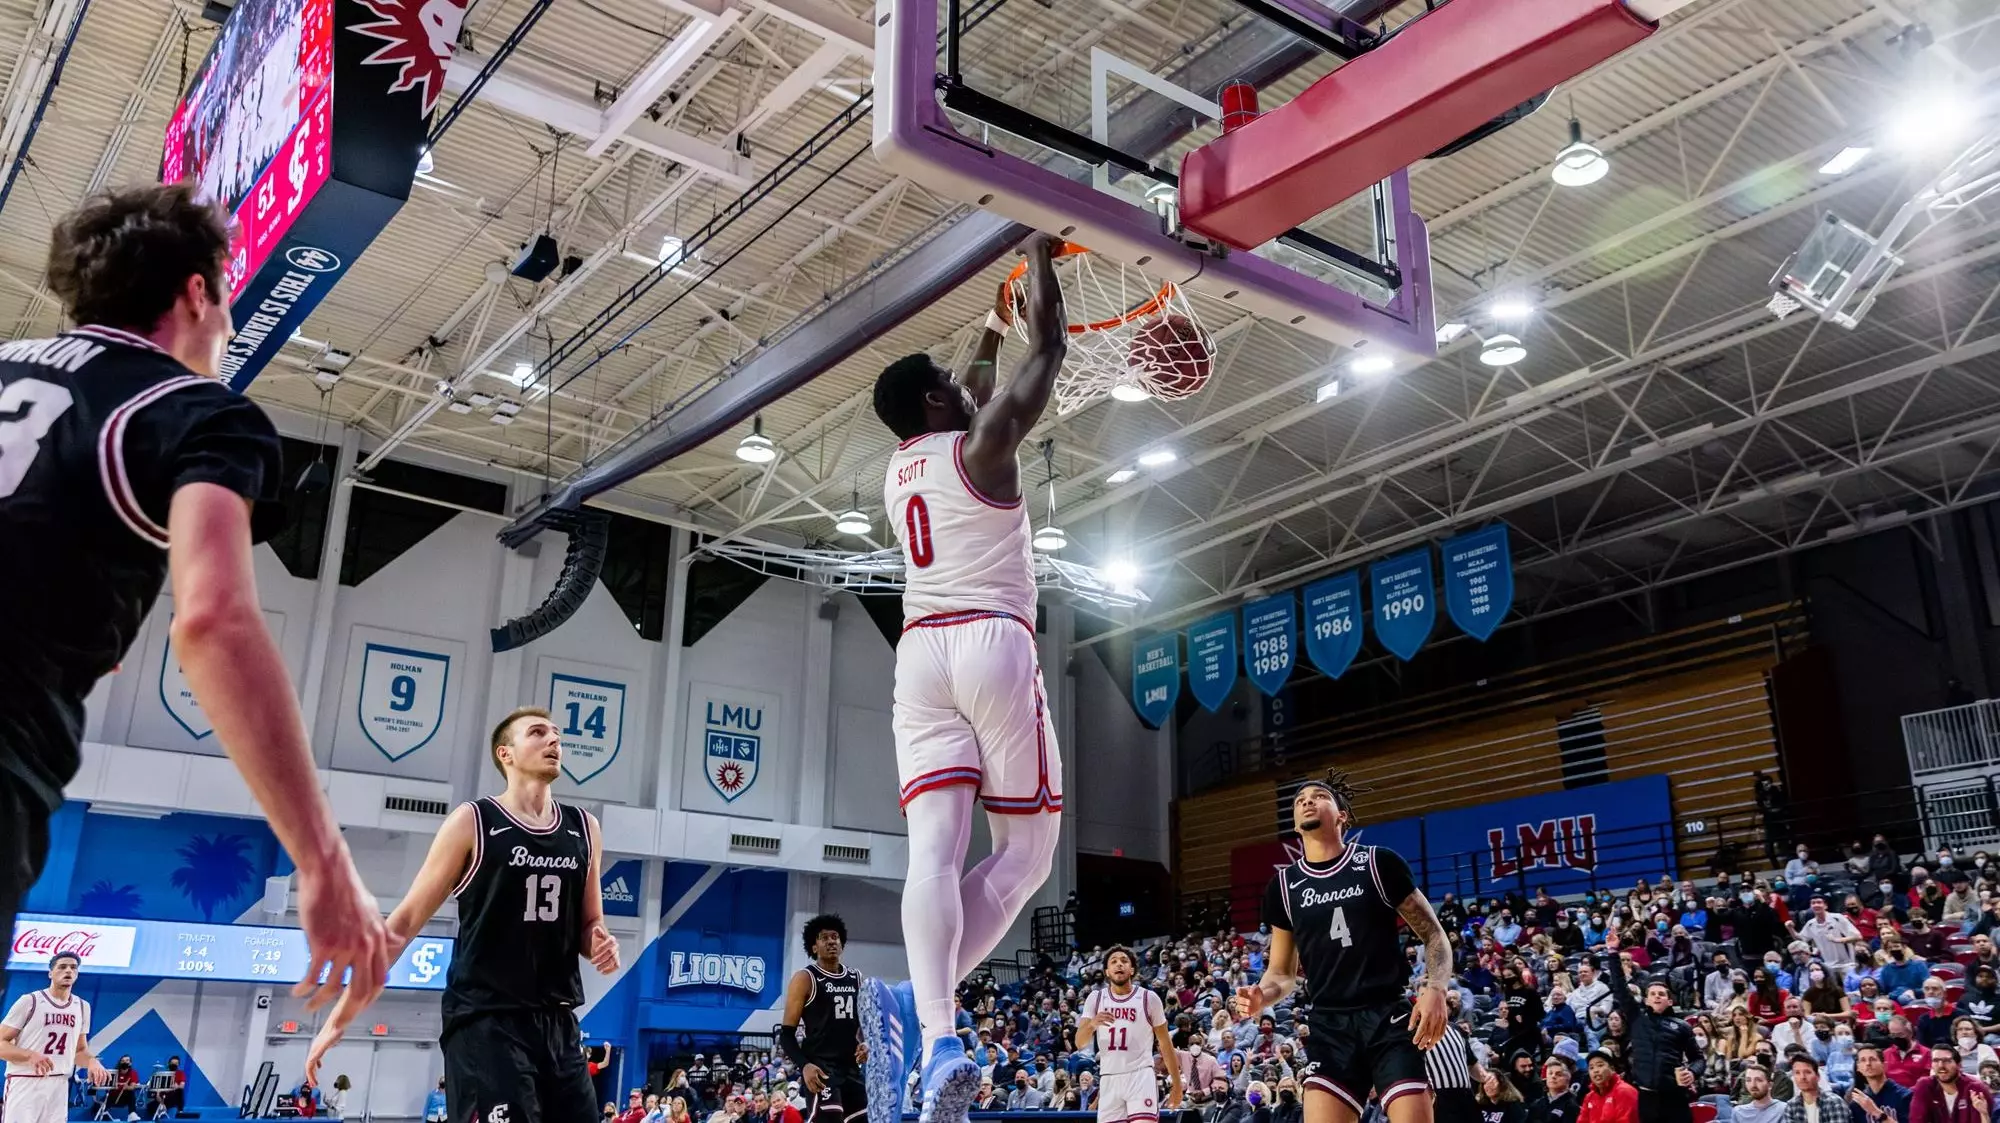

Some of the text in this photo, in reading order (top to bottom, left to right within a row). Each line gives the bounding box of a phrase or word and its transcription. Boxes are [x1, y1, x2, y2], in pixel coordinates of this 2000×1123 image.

[318, 113, 324, 135] 3
[317, 155, 323, 176] 3
[257, 172, 276, 221] 51
[296, 249, 330, 269] 44
[220, 270, 316, 386] THIS IS HANK'S HOUS
[0, 337, 107, 373] RAUN
[898, 458, 927, 486] SCOTT
[906, 494, 935, 569] 0
[1456, 561, 1497, 578] TOURNAMENT
[1316, 606, 1350, 620] APPEARANCE
[1382, 594, 1424, 620] 1990
[1314, 615, 1352, 640] 1986
[1146, 647, 1165, 661] MEN'S
[1253, 634, 1289, 658] 1988
[390, 662, 423, 674] HOLMAN
[1138, 656, 1174, 675] BASKETBALL
[1254, 652, 1289, 676] 1989
[390, 675, 416, 712] 9
[568, 690, 608, 702] McFARLAND
[1145, 684, 1168, 707] LMU
[563, 701, 607, 739] 14
[706, 701, 762, 731] LMU
[1685, 821, 1704, 833] 110
[508, 846, 579, 870] Broncos
[1487, 813, 1598, 884] LMU
[523, 874, 562, 922] 13
[601, 891, 633, 902] adidas
[1300, 884, 1364, 908] Broncos
[1330, 906, 1353, 948] 4
[14, 928, 102, 957] Coca-Cola
[183, 945, 208, 957] 4-4
[177, 960, 215, 972] 100%
[251, 949, 281, 961] 7-19
[252, 963, 278, 975] 37%
[668, 951, 766, 994] LIONS
[825, 982, 856, 993] Broncos
[834, 995, 854, 1019] 24
[44, 1013, 76, 1028] LIONS
[43, 1032, 68, 1055] 24
[1108, 1027, 1128, 1051] 11
